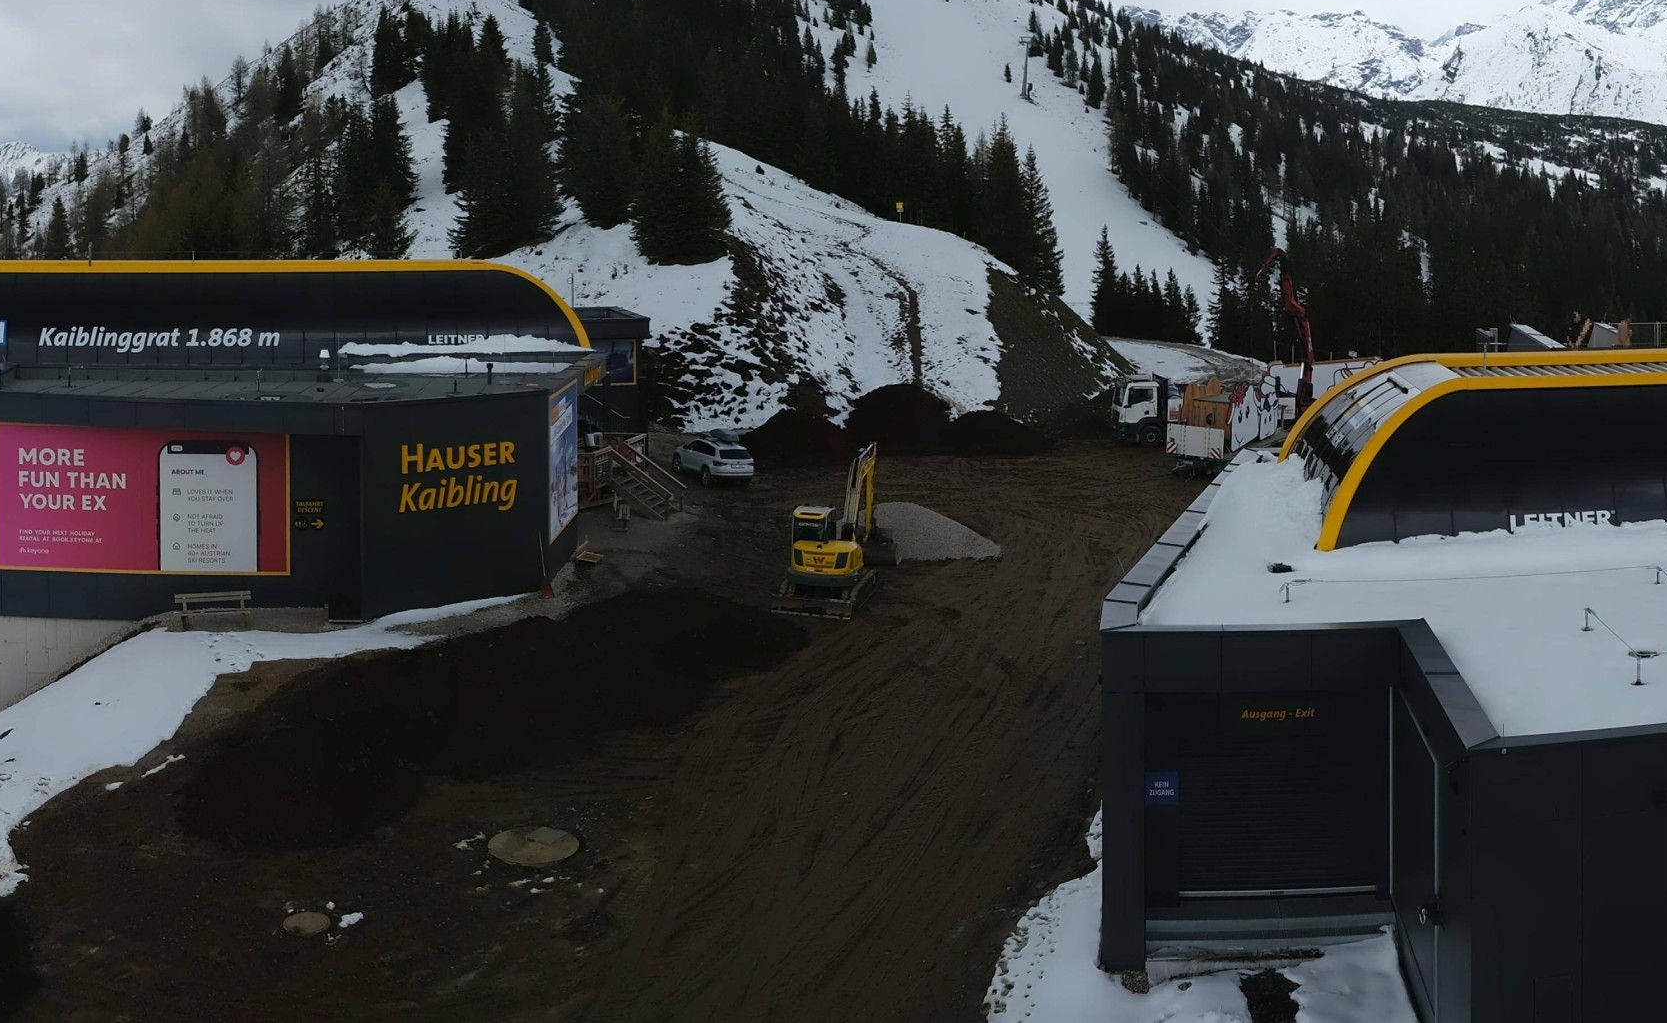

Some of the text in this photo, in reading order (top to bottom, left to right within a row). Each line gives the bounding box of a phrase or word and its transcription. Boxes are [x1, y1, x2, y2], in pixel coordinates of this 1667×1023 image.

[38, 326, 280, 352] Kaiblinggrat 1.868 m
[18, 448, 85, 466] MORE
[401, 441, 516, 474] HAUSER
[18, 470, 127, 489] FUN THAN
[20, 493, 107, 511] YOUR EX
[399, 475, 517, 512] Kaibling
[1241, 709, 1286, 721] Ausgang
[1295, 708, 1315, 718] Exit
